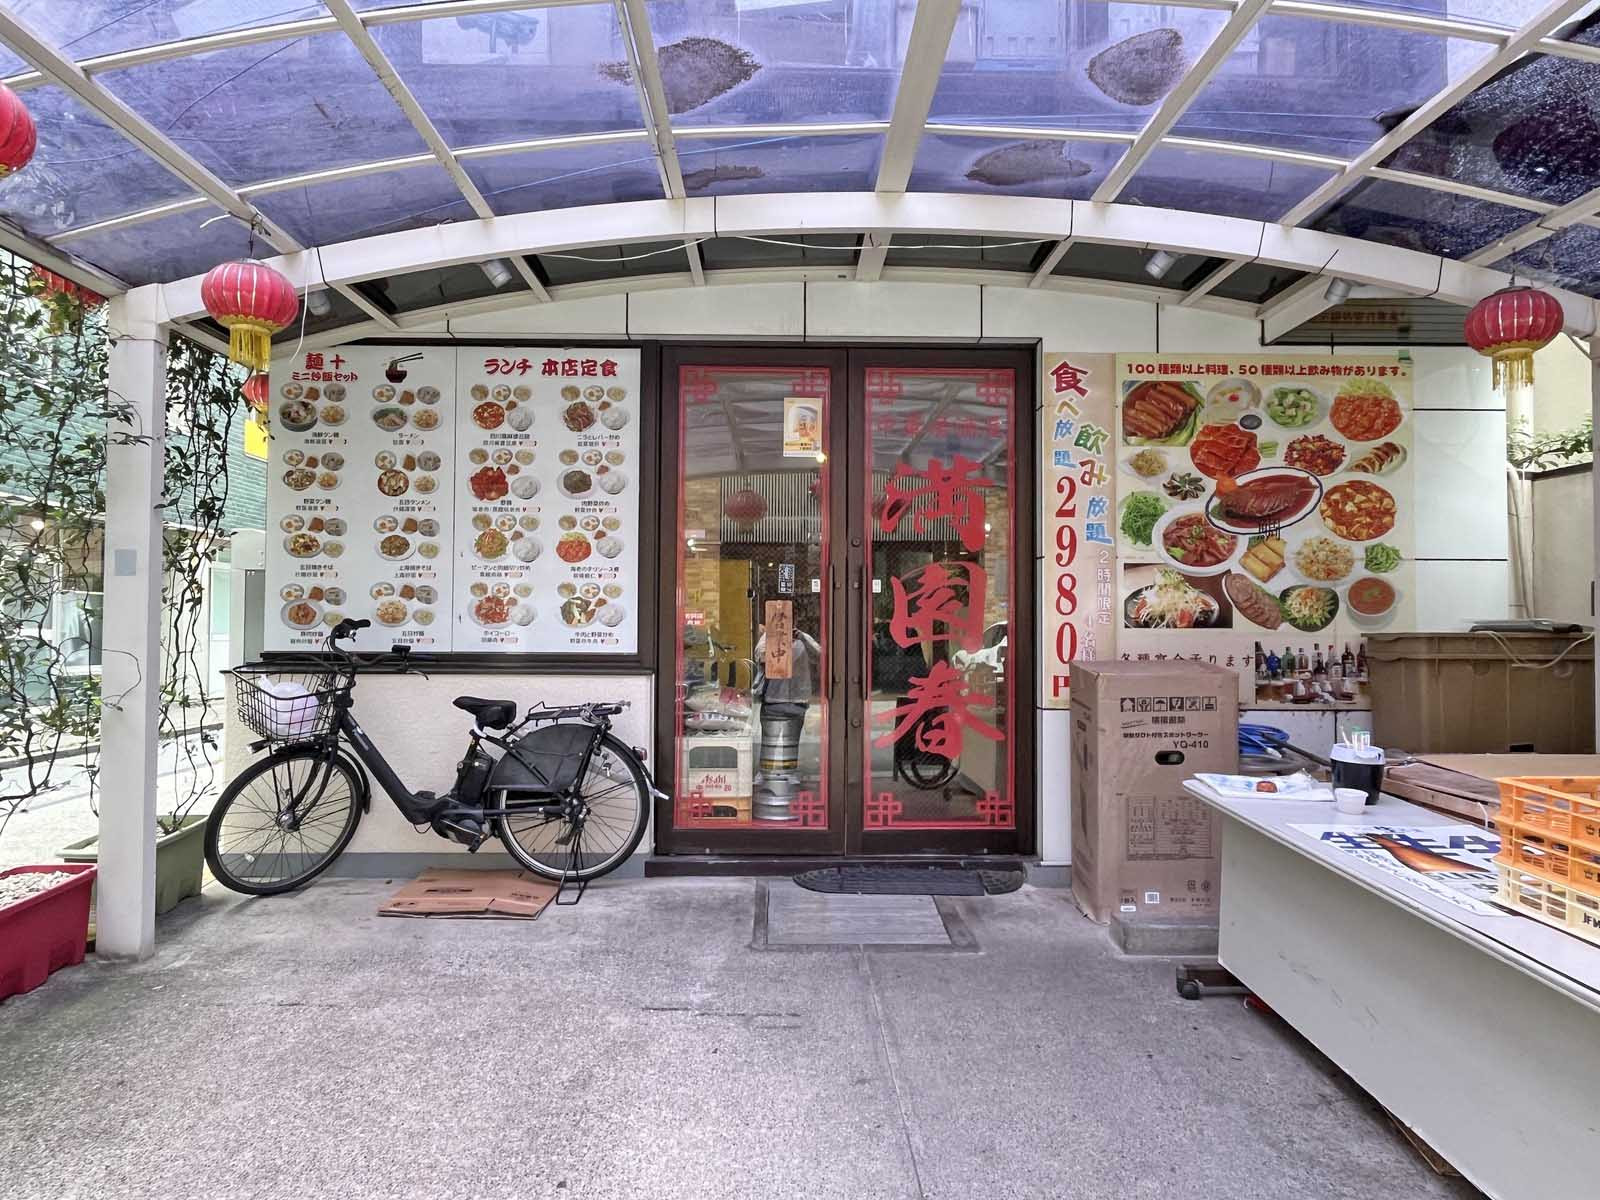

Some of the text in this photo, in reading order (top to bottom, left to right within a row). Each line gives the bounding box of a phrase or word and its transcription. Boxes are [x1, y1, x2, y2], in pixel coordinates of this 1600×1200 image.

[484, 358, 618, 377] ランチ 本店定食
[1050, 360, 1089, 469] 食べ放題
[1074, 423, 1114, 545] 飲み放題
[1173, 740, 1209, 749] YQ-410
[701, 773, 726, 785] Asahi
